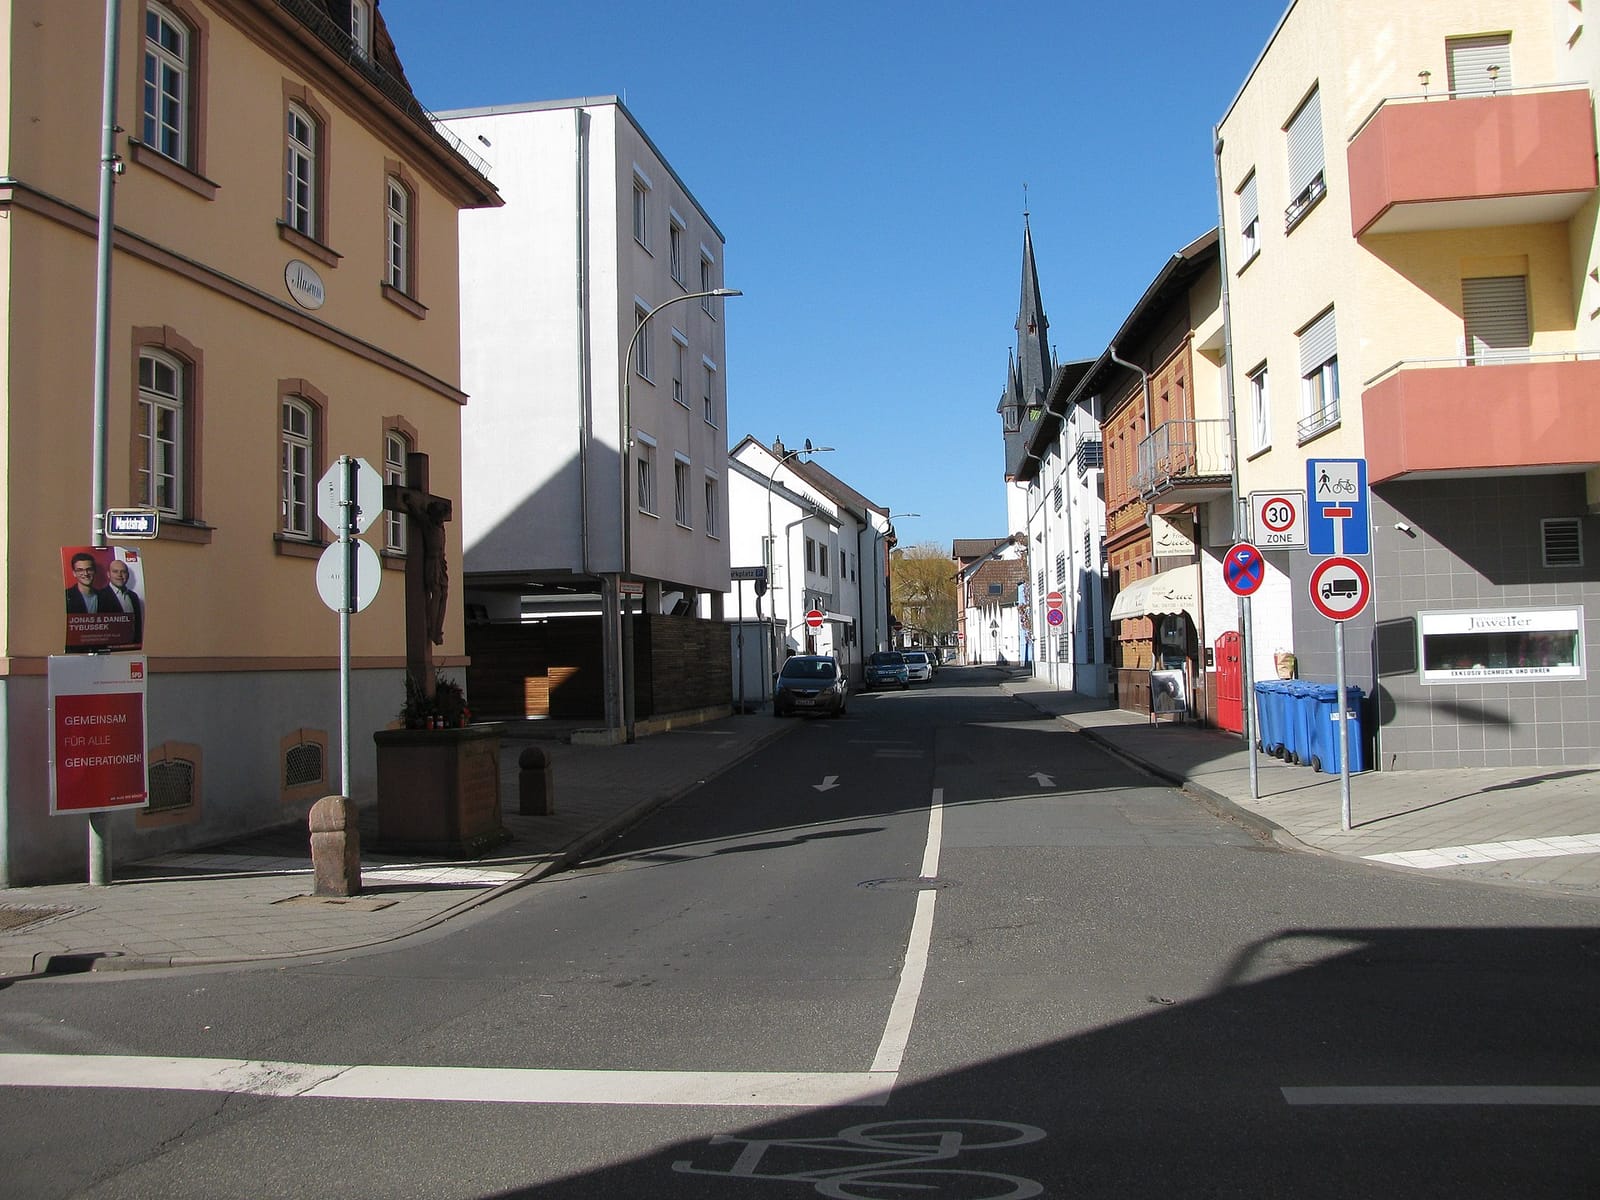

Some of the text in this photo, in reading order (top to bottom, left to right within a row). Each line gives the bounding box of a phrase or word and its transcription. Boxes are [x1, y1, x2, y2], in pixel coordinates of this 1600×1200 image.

[1269, 507, 1288, 523] 30
[1267, 534, 1293, 543] ZONE
[69, 616, 95, 624] JONAS
[103, 615, 130, 623] DANIEL
[1468, 616, 1532, 631] Juwelier
[69, 623, 109, 631] TYBUSSEK
[64, 714, 127, 726] GEMEINSAM
[64, 735, 111, 747] FÜR ALLE
[65, 753, 142, 768] GENERATIONEN!
